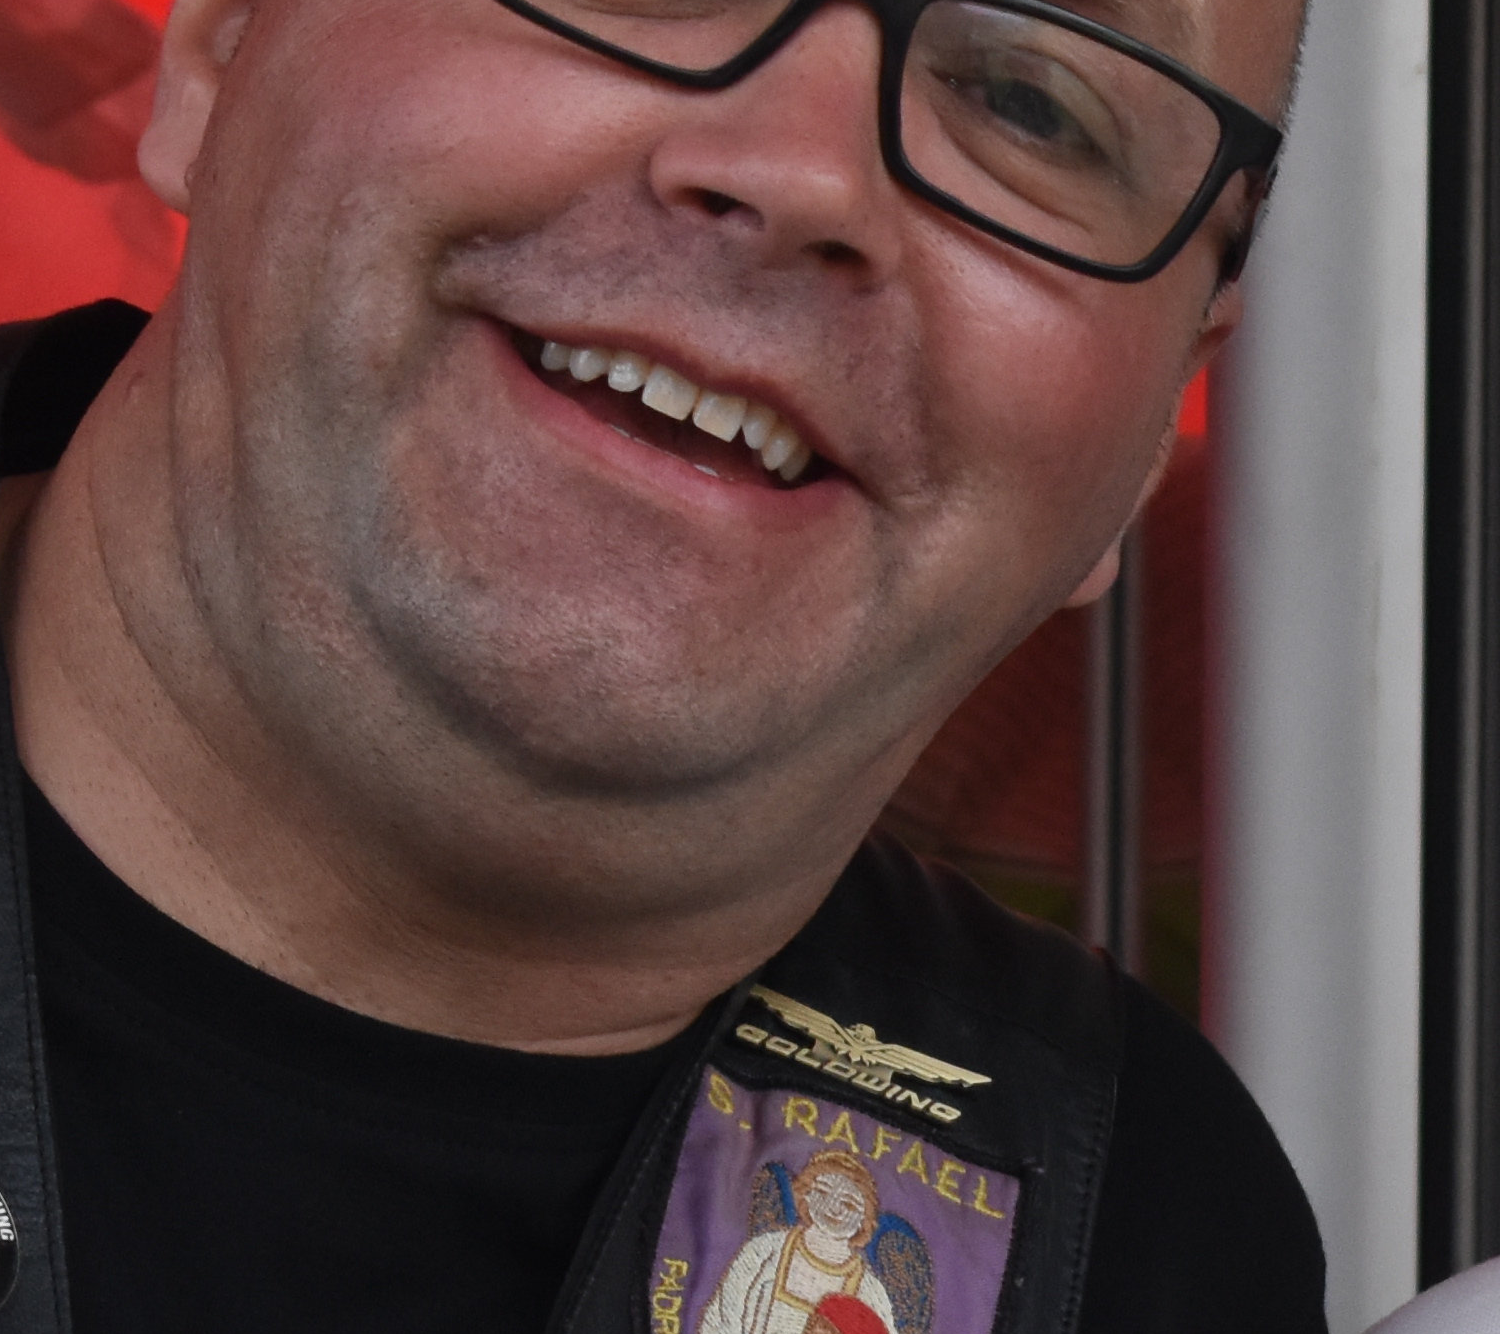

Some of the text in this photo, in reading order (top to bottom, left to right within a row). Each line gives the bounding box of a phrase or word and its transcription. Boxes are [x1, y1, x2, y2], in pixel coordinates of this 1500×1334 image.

[735, 1022, 962, 1124] GOLDWING
[708, 1072, 1006, 1220] S. RAFAEL
